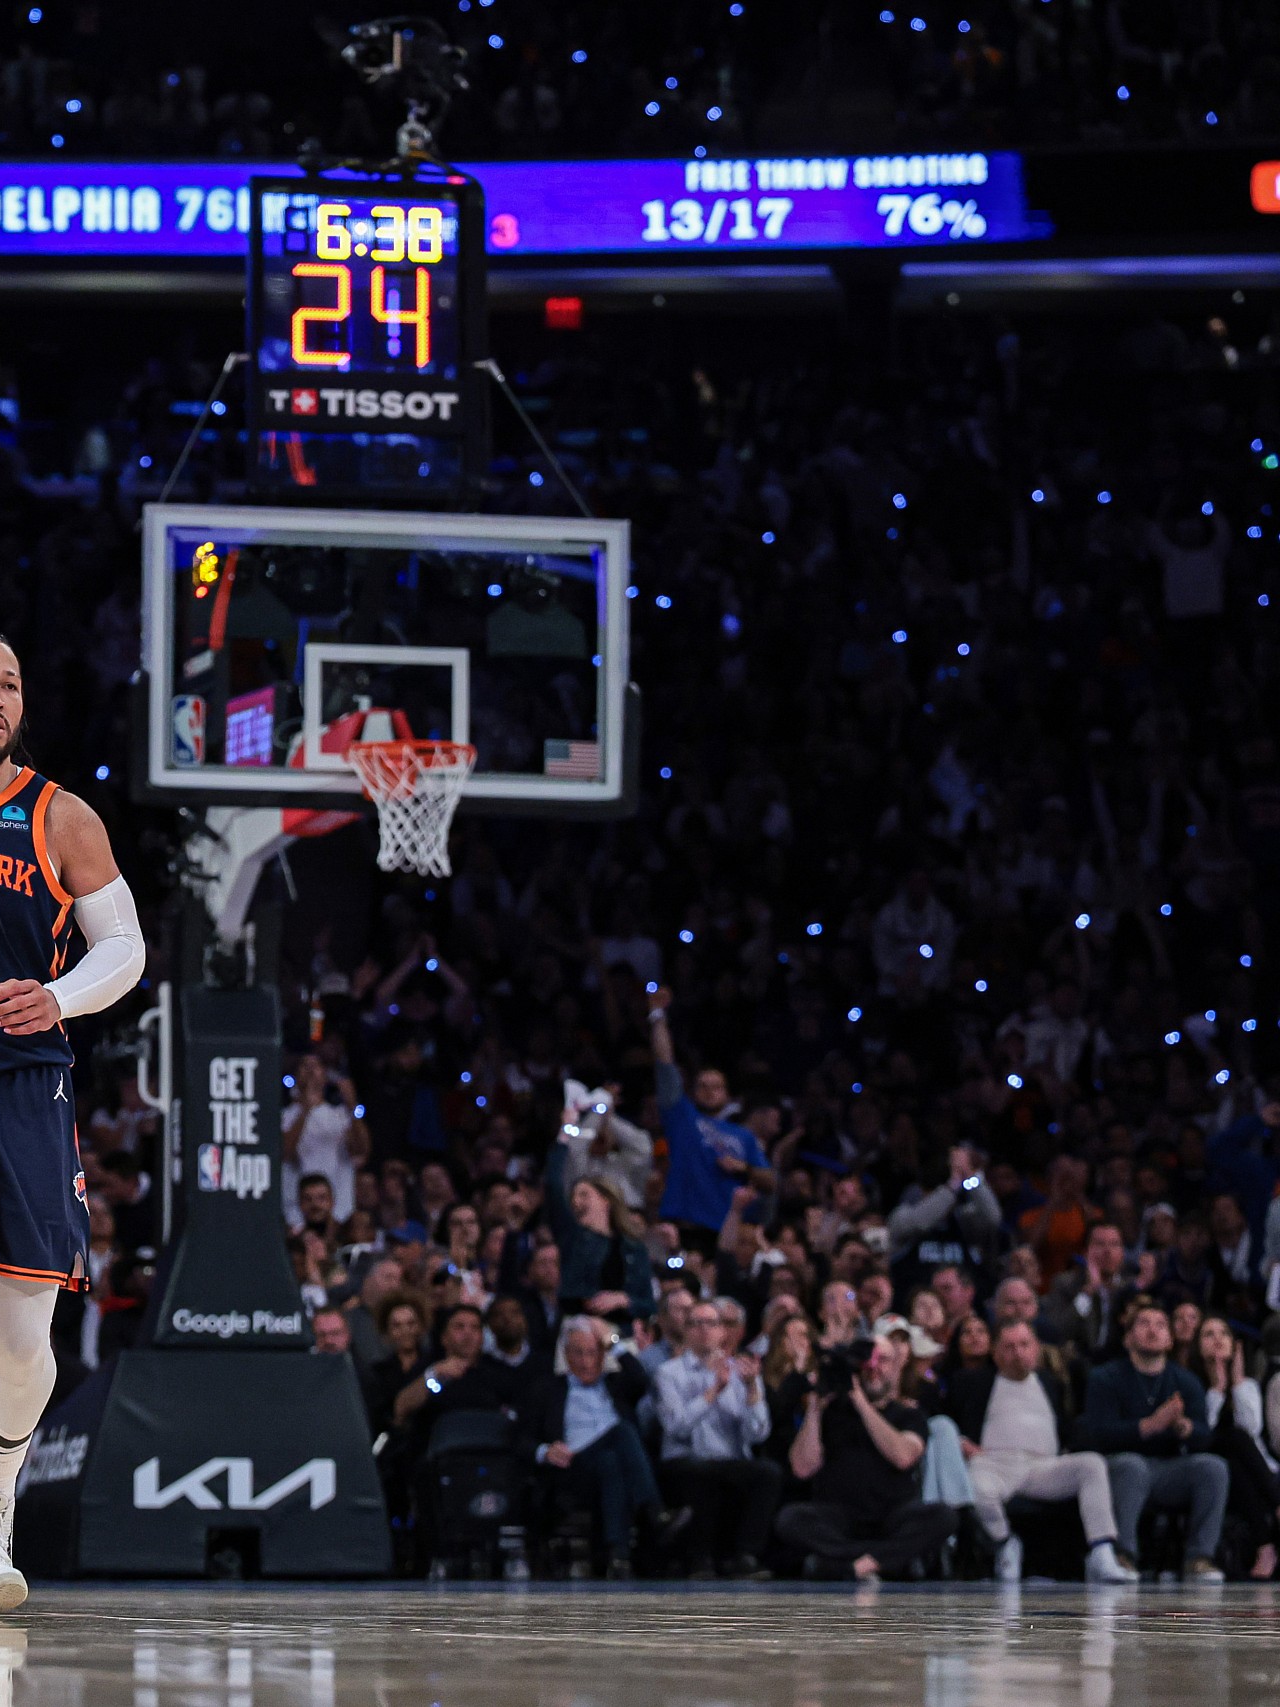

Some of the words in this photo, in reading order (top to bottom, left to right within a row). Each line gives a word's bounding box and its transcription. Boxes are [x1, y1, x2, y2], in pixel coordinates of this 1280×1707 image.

[317, 204, 443, 263] 6:38
[491, 213, 519, 249] 3
[641, 196, 793, 244] 13/17
[877, 192, 987, 240] 76%
[291, 263, 430, 367] 24
[319, 388, 459, 420] TISSOT
[208, 1056, 259, 1100] GET
[208, 1101, 259, 1144] THE
[220, 1146, 271, 1199] App
[172, 1308, 250, 1338] Google
[253, 1310, 302, 1334] Pixel
